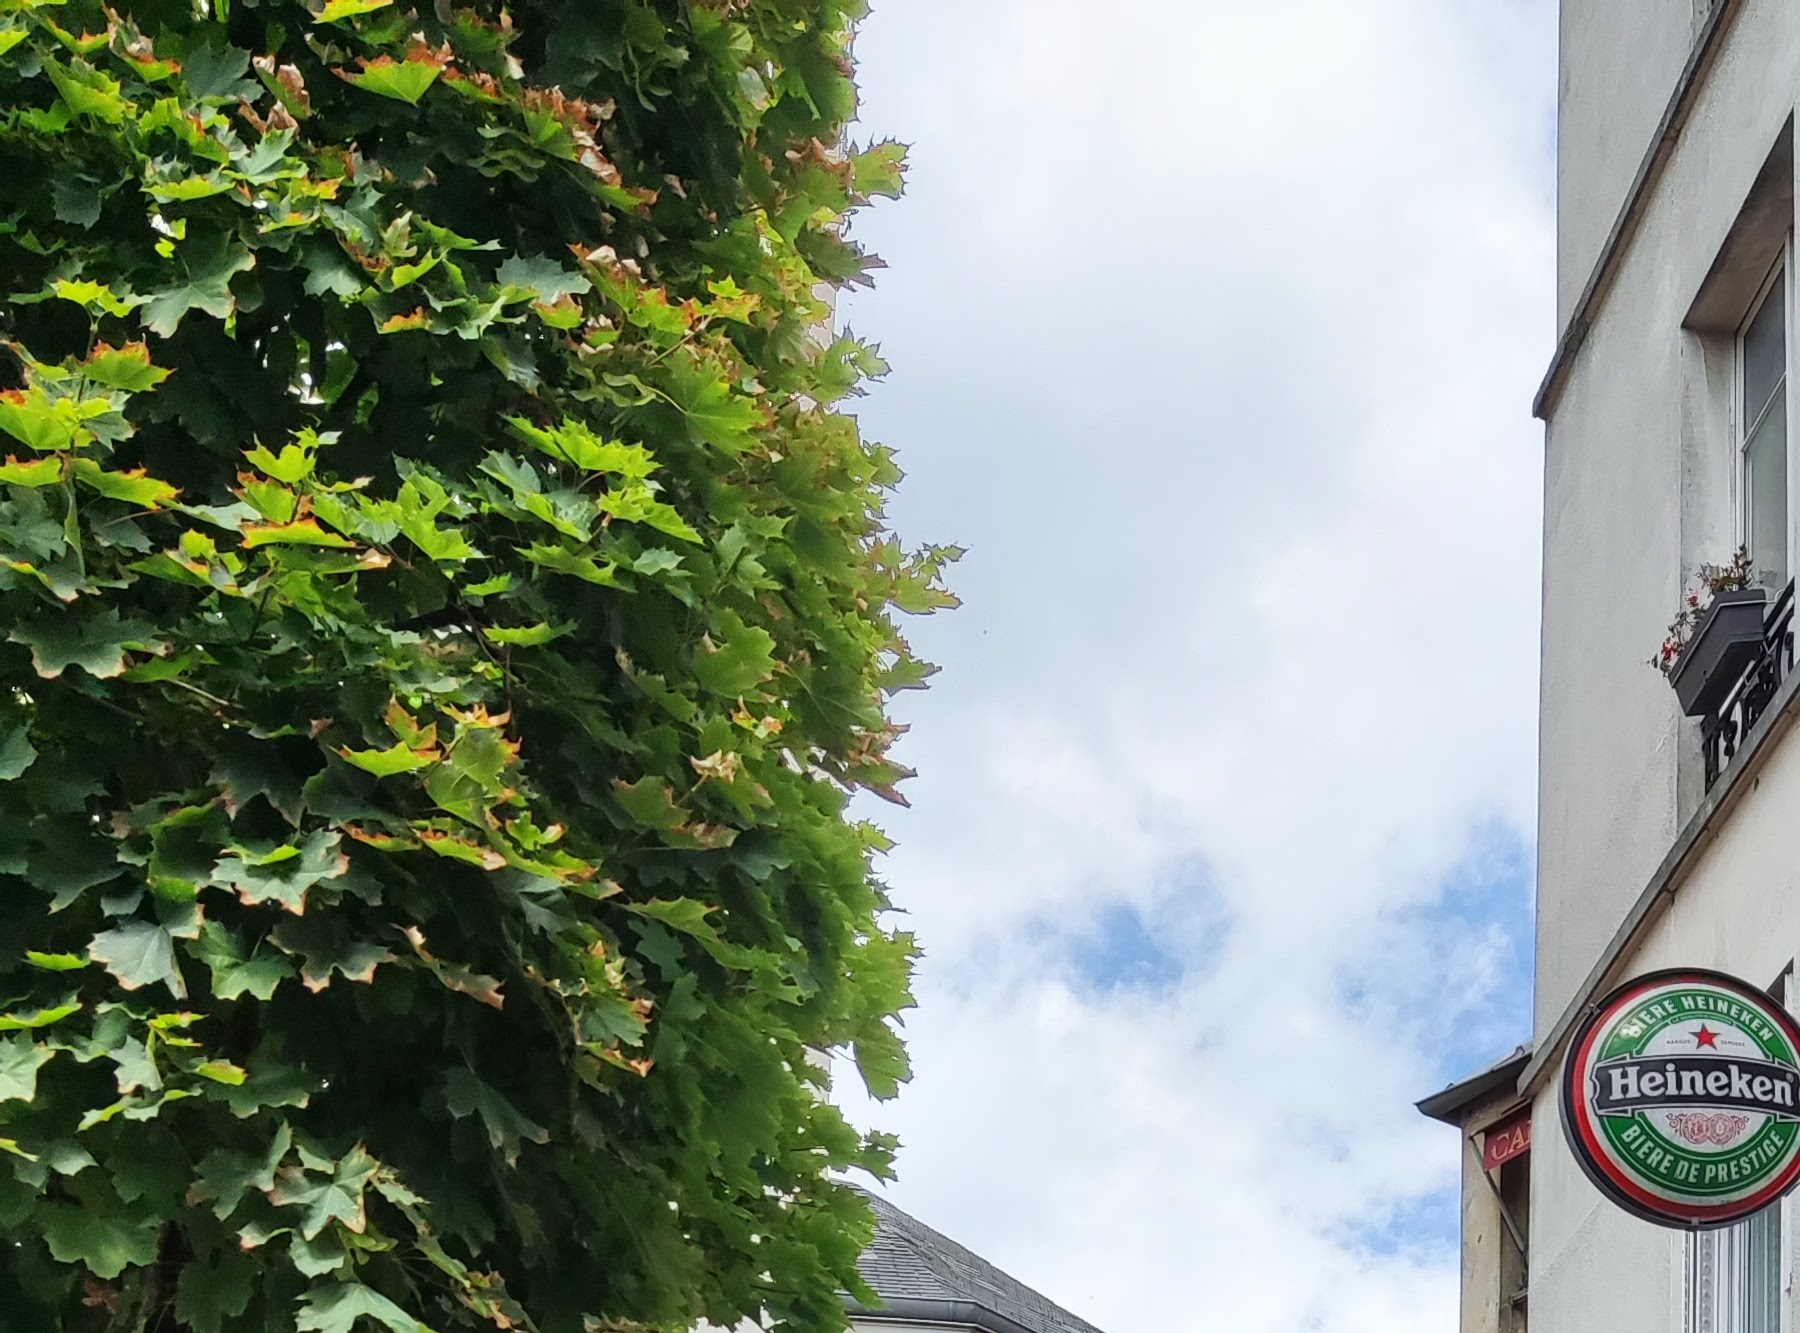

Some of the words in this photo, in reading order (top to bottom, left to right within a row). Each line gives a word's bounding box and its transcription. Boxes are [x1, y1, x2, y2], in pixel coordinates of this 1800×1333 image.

[1680, 995, 1774, 1042] HEINEKEN
[1608, 1062, 1794, 1107] Heineken
[1620, 1124, 1675, 1174] BIERE
[1674, 1160, 1700, 1183] DE
[1705, 1130, 1786, 1184] PRESTIGE
